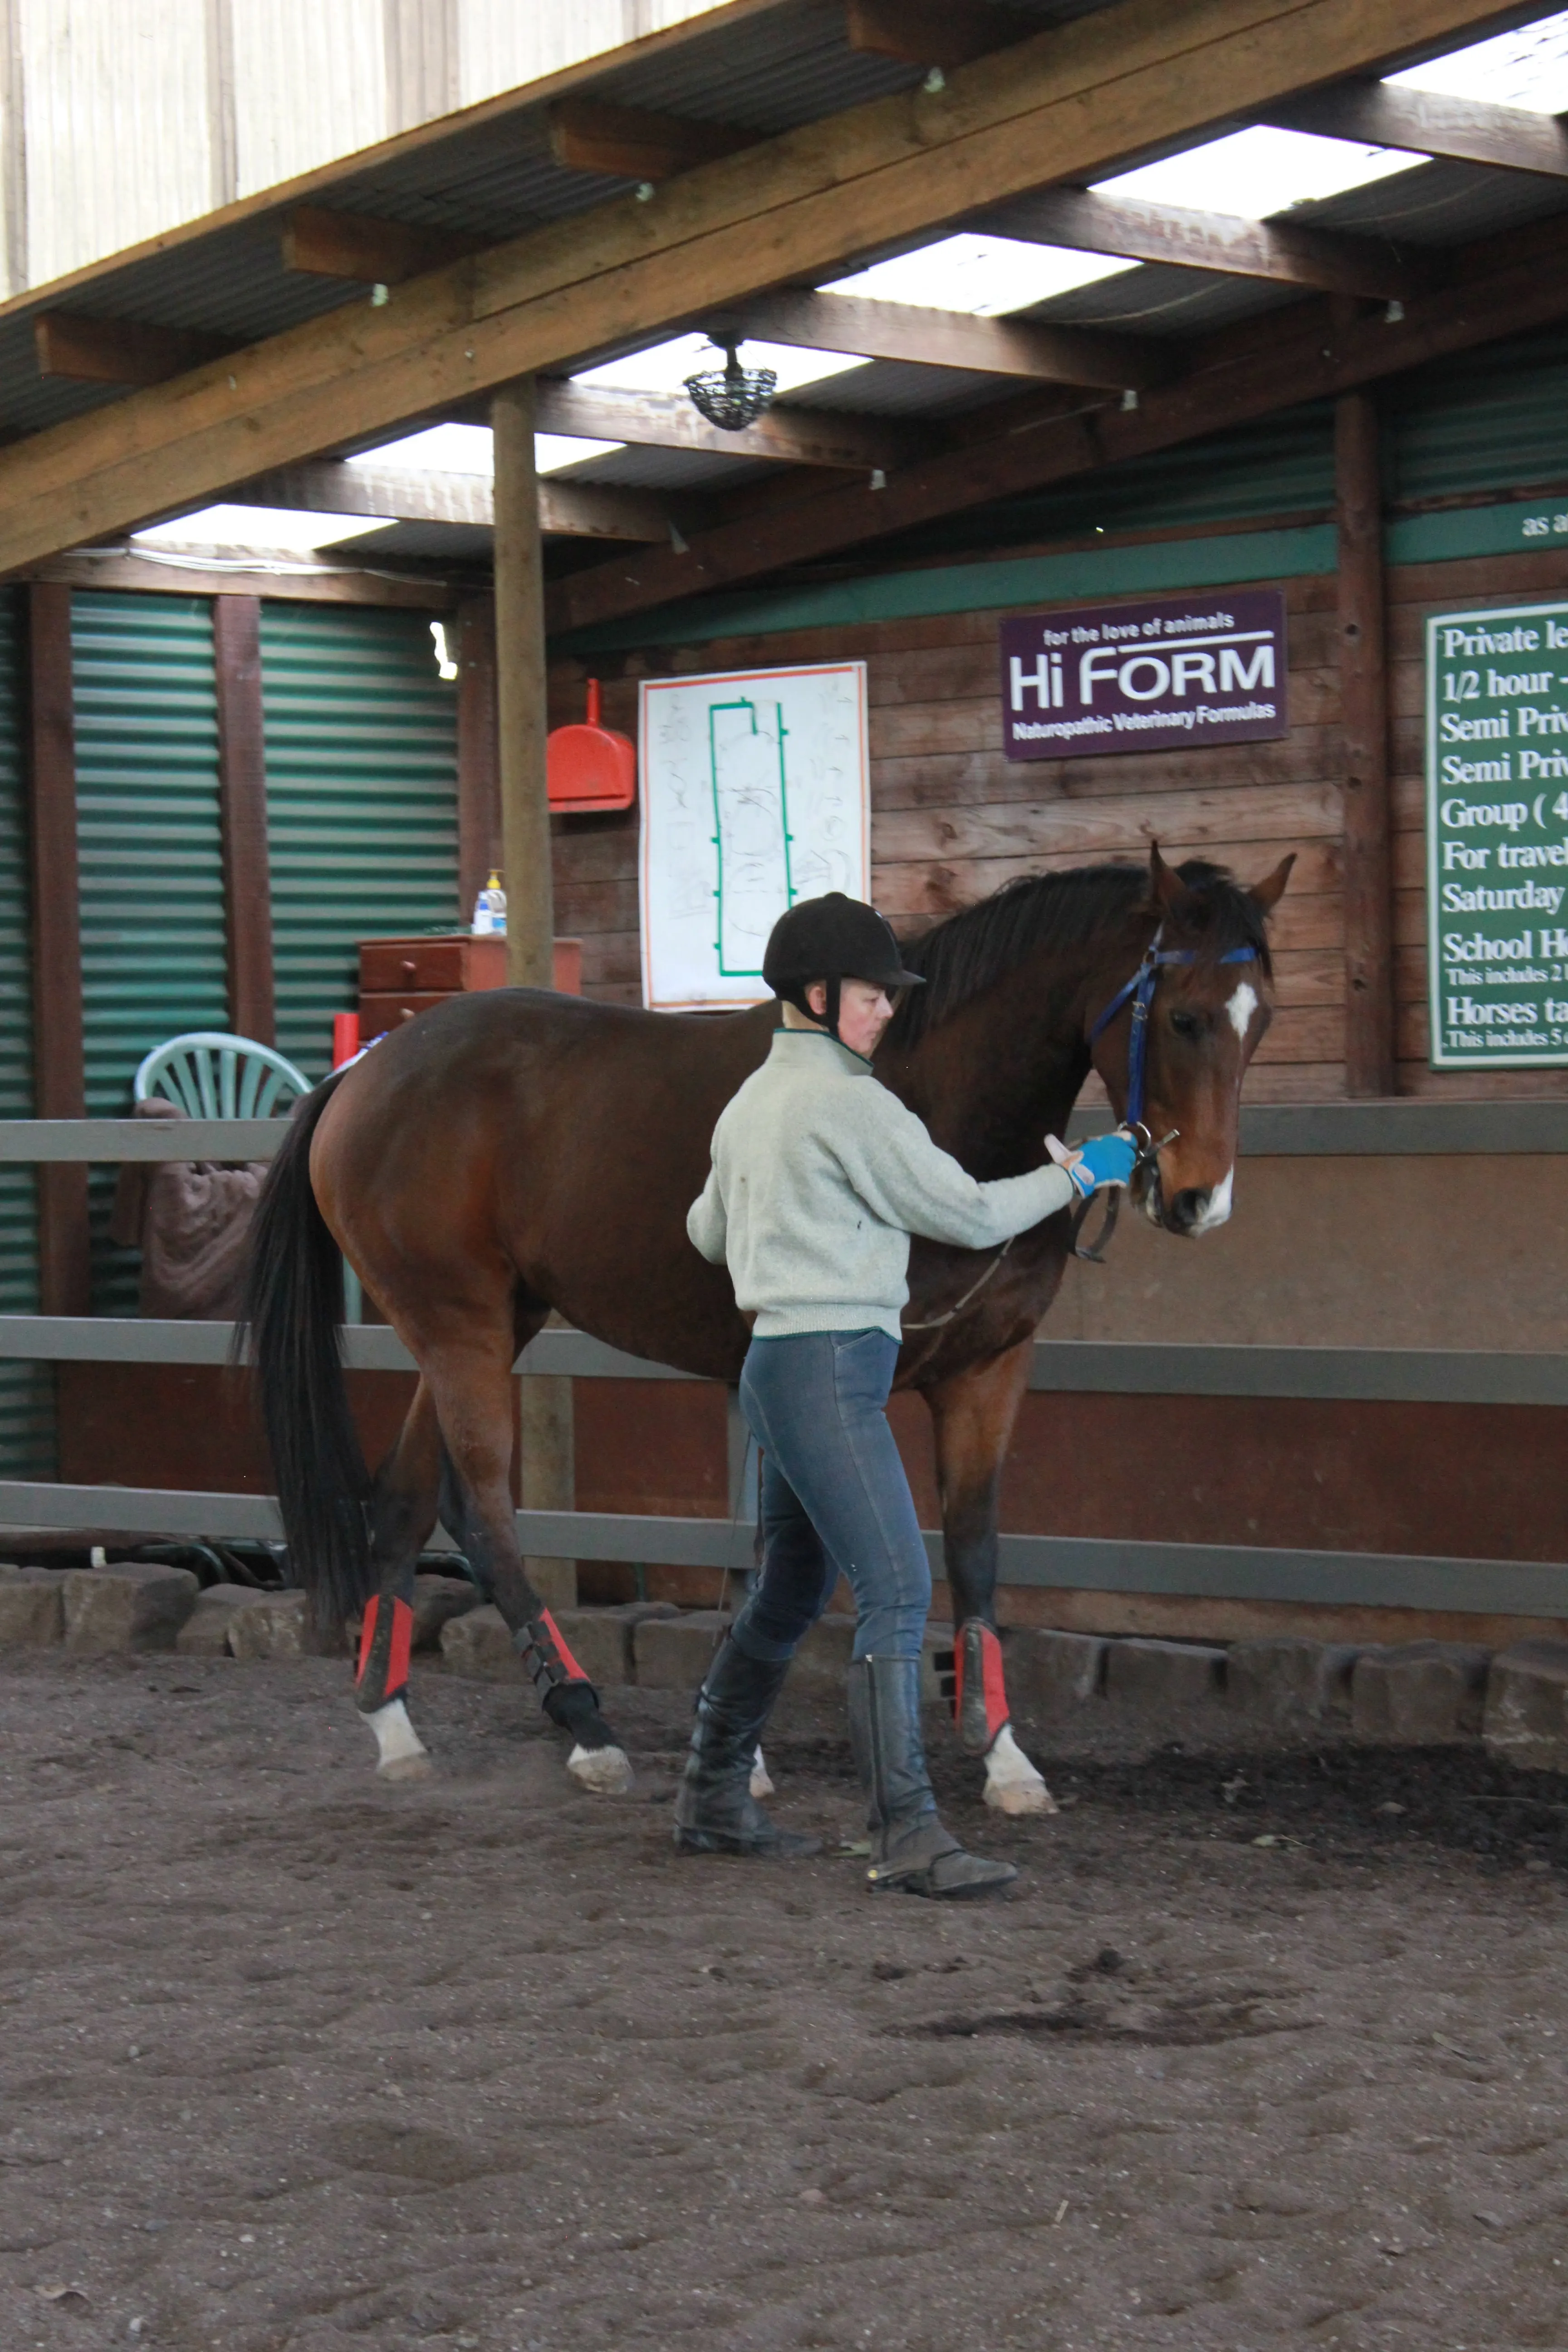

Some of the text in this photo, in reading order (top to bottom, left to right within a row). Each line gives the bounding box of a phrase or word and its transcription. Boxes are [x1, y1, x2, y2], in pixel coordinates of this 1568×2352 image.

[1522, 514, 1568, 537] as a
[1044, 612, 1235, 646] for the love of animals
[1442, 626, 1540, 658] Private
[1010, 652, 1063, 711] Hi
[1442, 670, 1481, 704] 1/2
[1485, 668, 1554, 698] hour
[1012, 701, 1276, 740] Naturopathic Veterinary Formulas
[1440, 709, 1511, 743] Semi
[1441, 752, 1512, 785] Semi
[1441, 799, 1529, 832] Group
[1442, 841, 1491, 870] For
[1442, 880, 1566, 916] Saturday
[1443, 930, 1534, 962] School
[1445, 967, 1484, 985] This
[1485, 965, 1549, 985] includes
[1550, 964, 1563, 982] 2
[1446, 996, 1539, 1025] Horses
[1446, 1029, 1484, 1048] This
[1485, 1029, 1549, 1047] includes
[1550, 1028, 1563, 1046] 5
